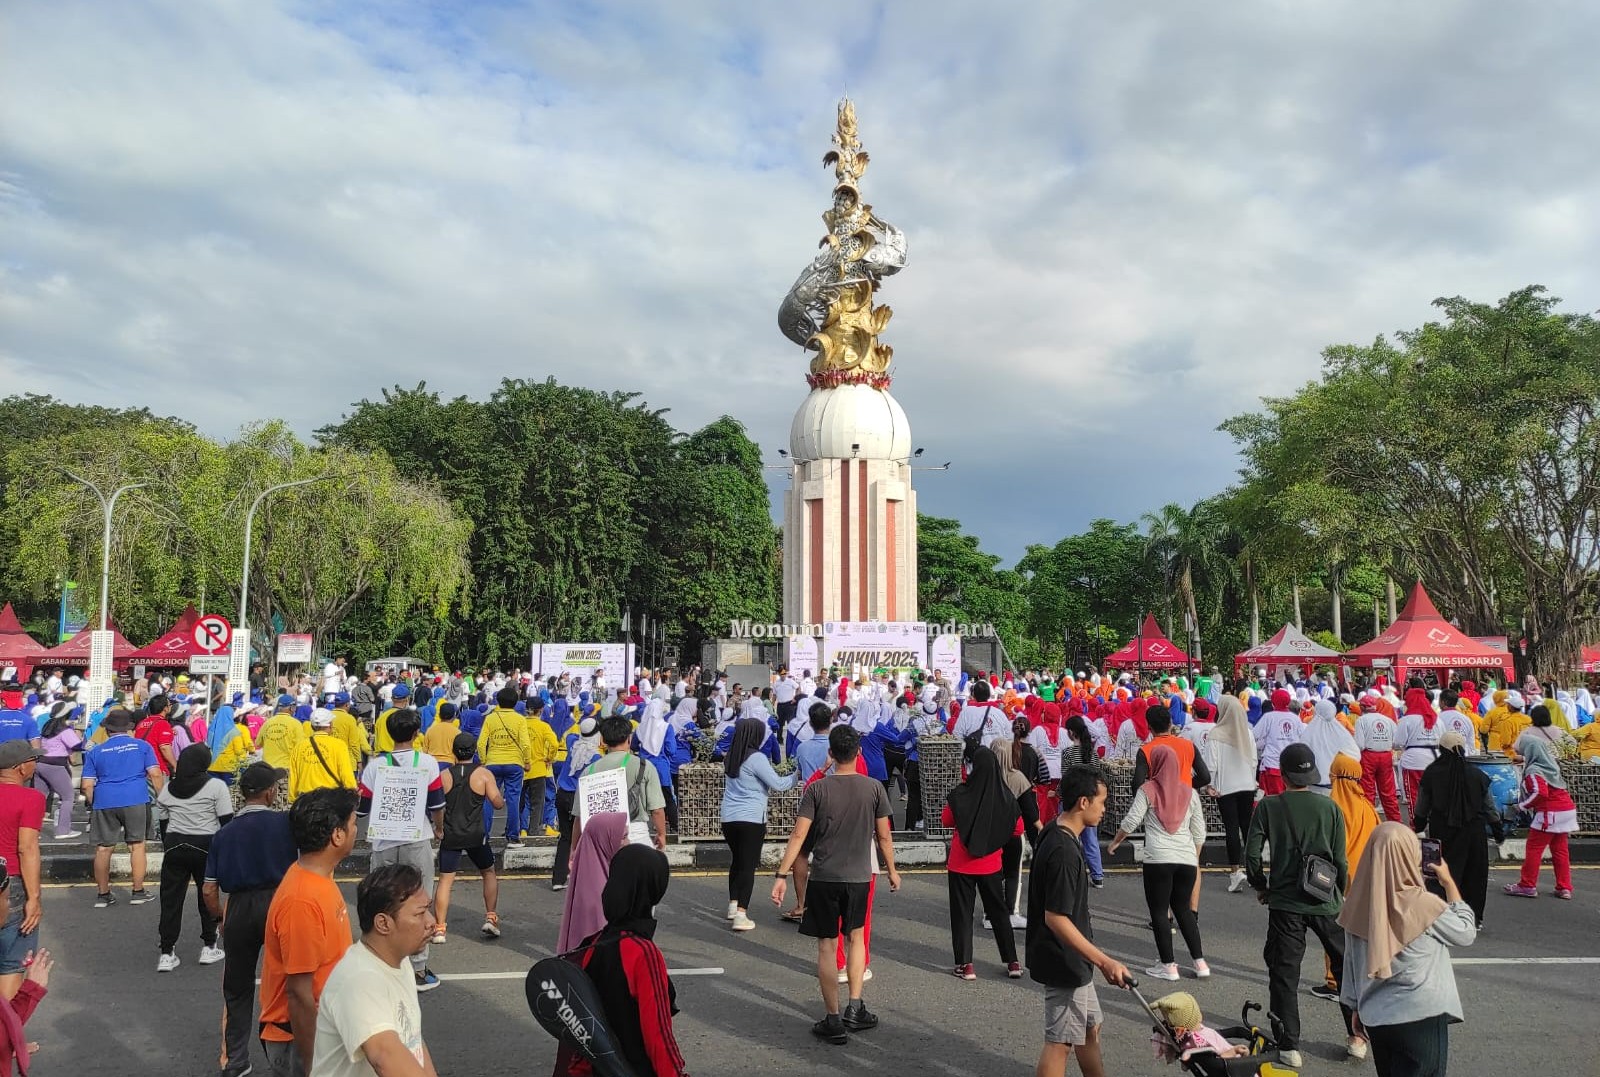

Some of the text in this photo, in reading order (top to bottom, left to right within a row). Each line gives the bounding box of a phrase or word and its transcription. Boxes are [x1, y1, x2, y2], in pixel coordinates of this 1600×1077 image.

[730, 620, 823, 638] Monum
[928, 618, 994, 637] ndaru
[837, 651, 880, 667] HAKIN
[883, 651, 919, 667] 2025
[1406, 656, 1503, 666] CABANG SIDOARJO
[558, 998, 592, 1046] YONEX
